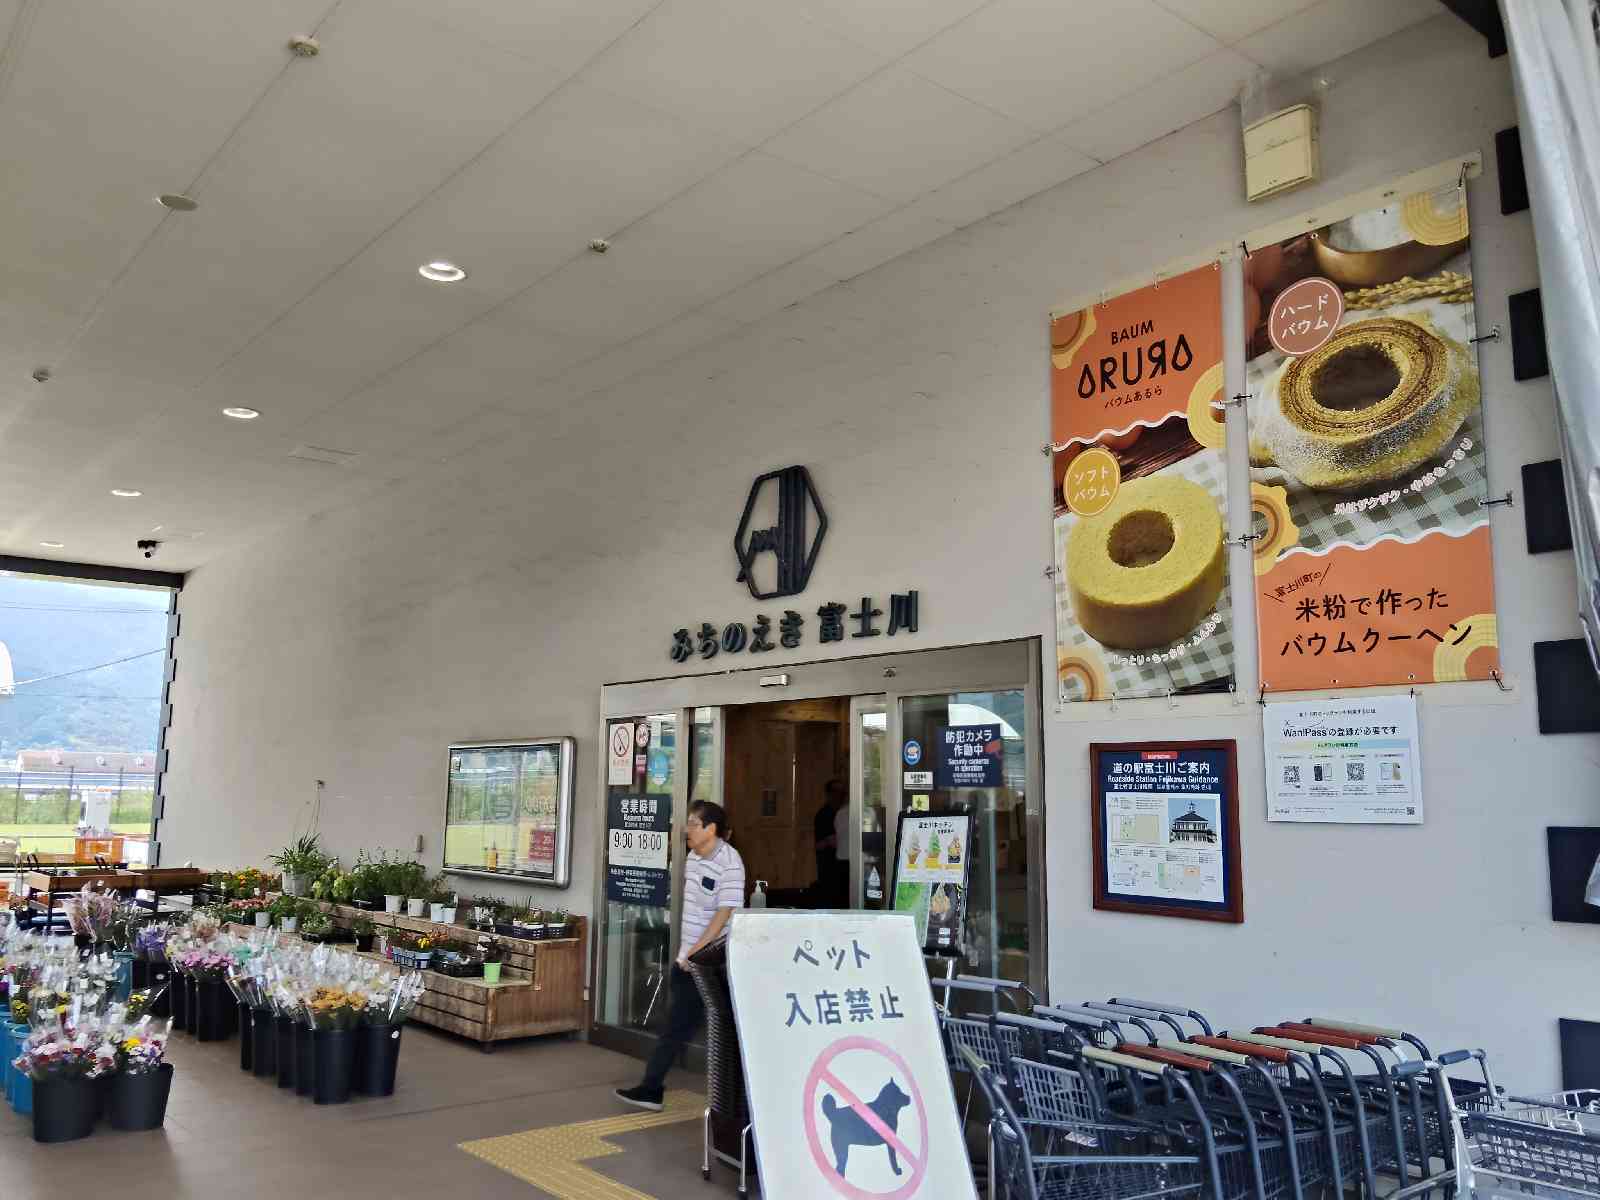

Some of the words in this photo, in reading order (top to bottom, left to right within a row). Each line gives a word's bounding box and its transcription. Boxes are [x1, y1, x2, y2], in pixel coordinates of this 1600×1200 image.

[1280, 294, 1329, 319] ハード
[1110, 319, 1154, 345] BAUM
[1281, 315, 1329, 339] バウム
[1073, 465, 1110, 485] ソフト
[1073, 486, 1111, 502] バウム
[1295, 587, 1449, 623] 米粉で作った
[816, 590, 919, 643] 富士川
[1280, 623, 1472, 657] バウムクーヘン
[945, 729, 992, 744] 防犯カメラ
[953, 743, 984, 757] 作動中
[1107, 774, 1135, 783] Roadside
[1135, 775, 1157, 783] Station
[1188, 775, 1219, 784] Guidance
[1113, 761, 1210, 775] 道の駅富士川ご案内
[620, 798, 658, 815] 営業時間
[614, 831, 633, 849] 9:00
[638, 833, 662, 850] 18:00
[792, 939, 871, 971] ペット
[784, 985, 905, 1028] 入店禁止
